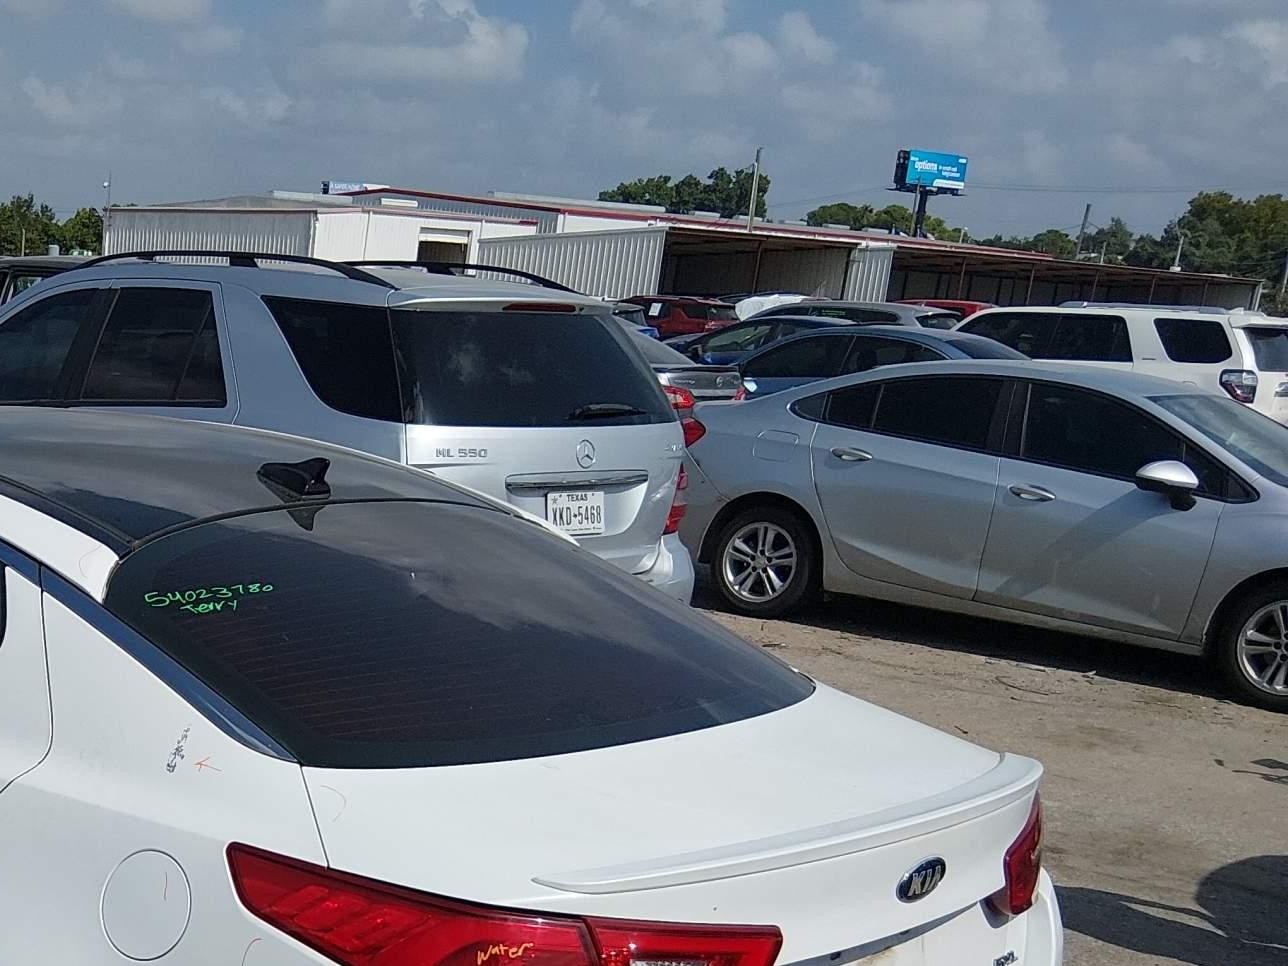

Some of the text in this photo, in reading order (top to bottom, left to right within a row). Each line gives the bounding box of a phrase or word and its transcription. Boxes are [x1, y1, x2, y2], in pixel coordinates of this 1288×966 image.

[435, 448, 488, 458] ML 550
[566, 493, 589, 502] TEXAS
[144, 583, 274, 607] 54023780
